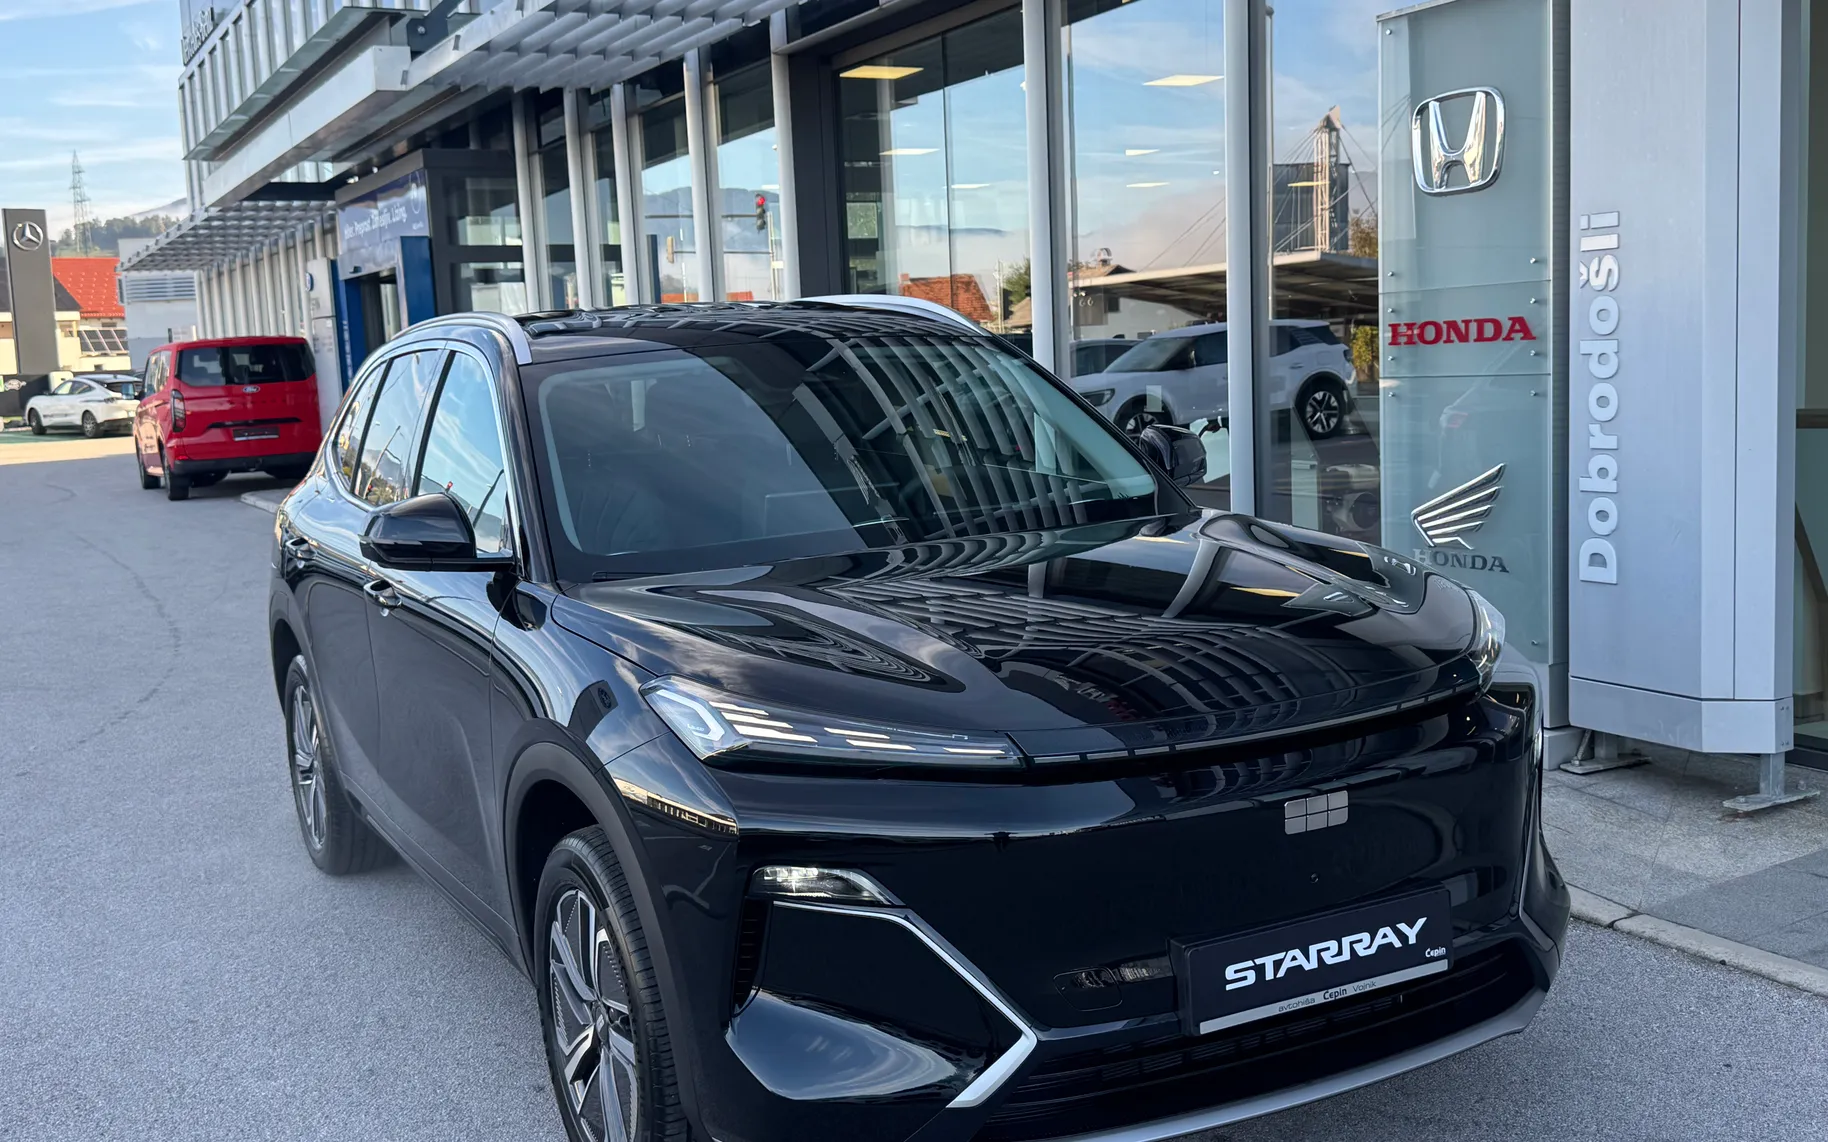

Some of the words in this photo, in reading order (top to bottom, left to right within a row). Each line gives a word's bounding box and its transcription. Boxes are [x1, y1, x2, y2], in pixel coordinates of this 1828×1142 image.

[1388, 315, 1536, 346] HONDA
[1579, 211, 1620, 585] Dobrodošli
[1412, 548, 1510, 573] HONDA
[1225, 917, 1427, 991] STARRAY
[1352, 980, 1377, 992] Vojnik
